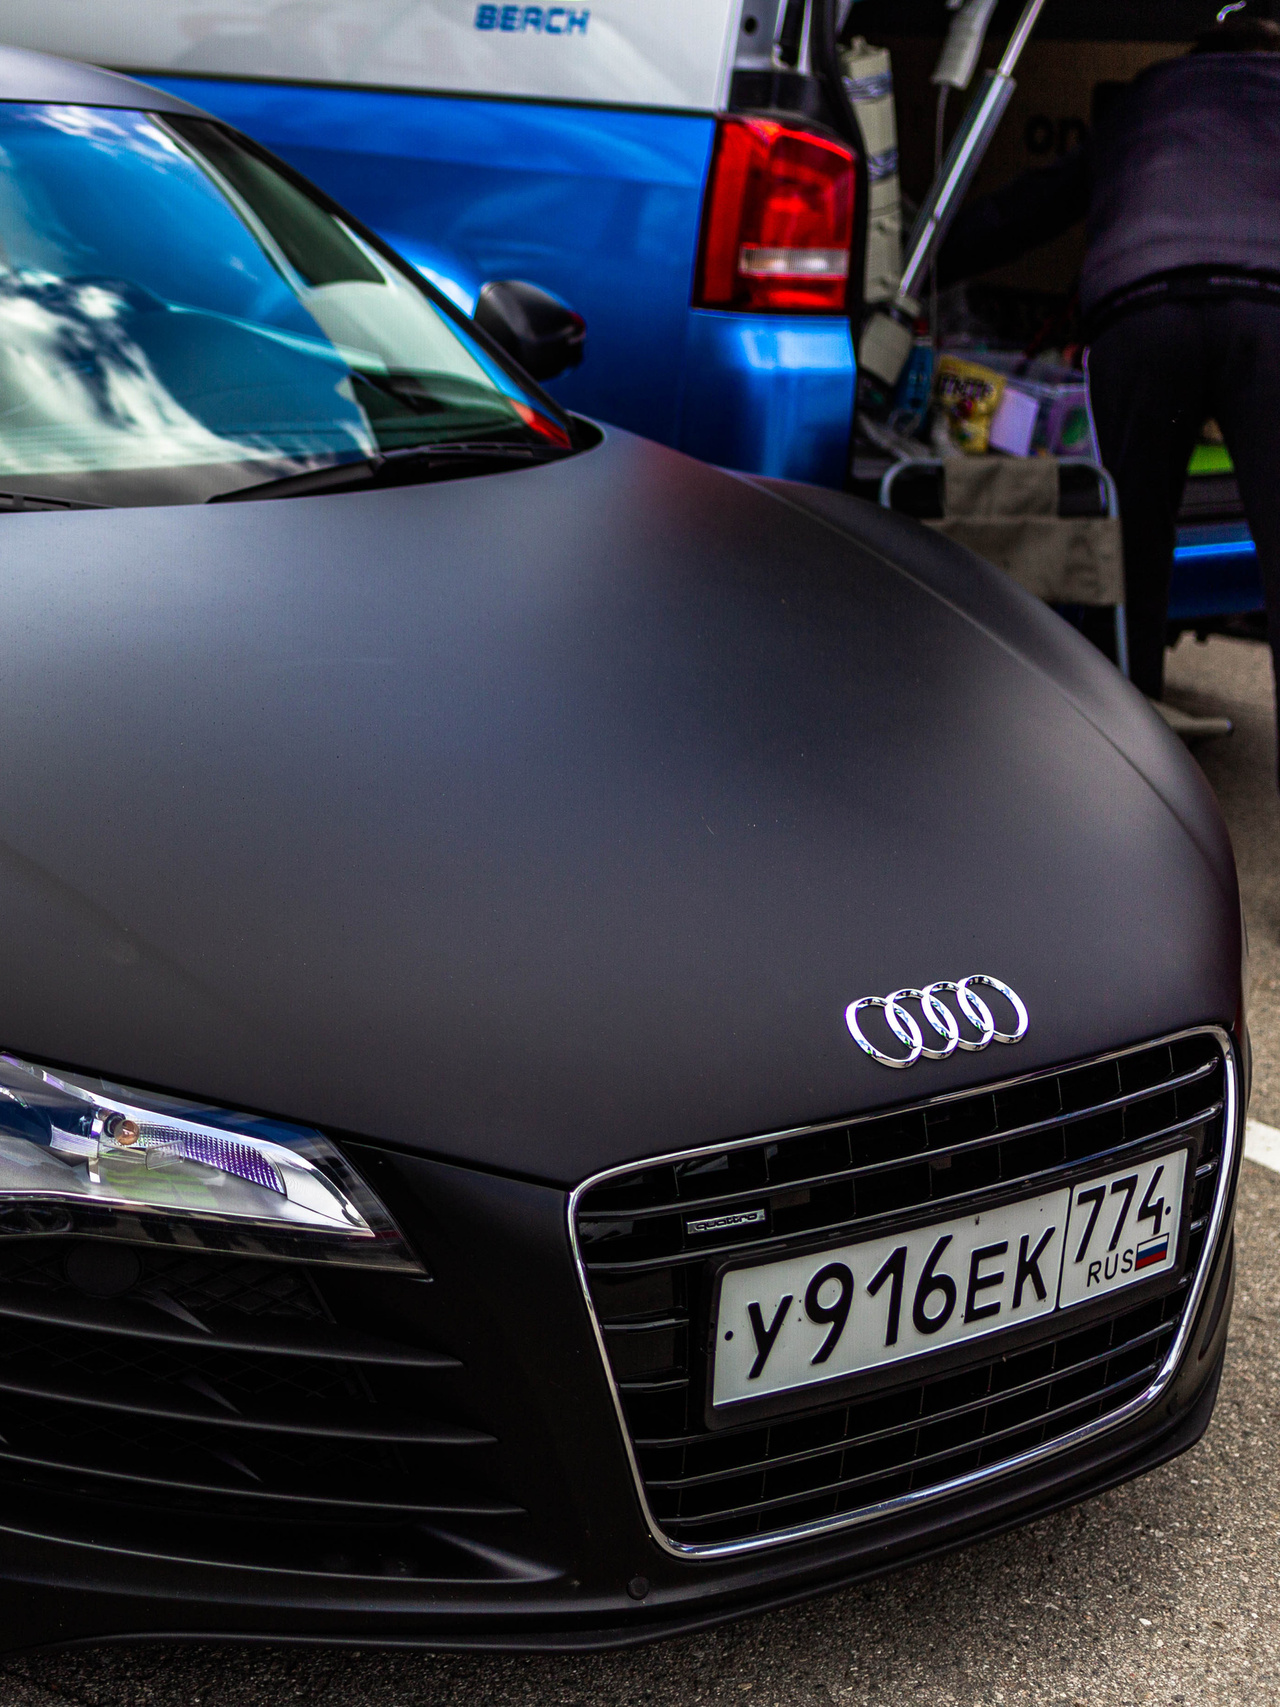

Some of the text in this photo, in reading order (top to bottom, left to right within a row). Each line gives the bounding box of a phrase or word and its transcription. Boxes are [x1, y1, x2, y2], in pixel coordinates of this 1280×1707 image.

[475, 4, 590, 35] BEACH
[696, 1213, 757, 1230] quattro
[1073, 1164, 1165, 1263] 774
[1086, 1248, 1134, 1288] RUS
